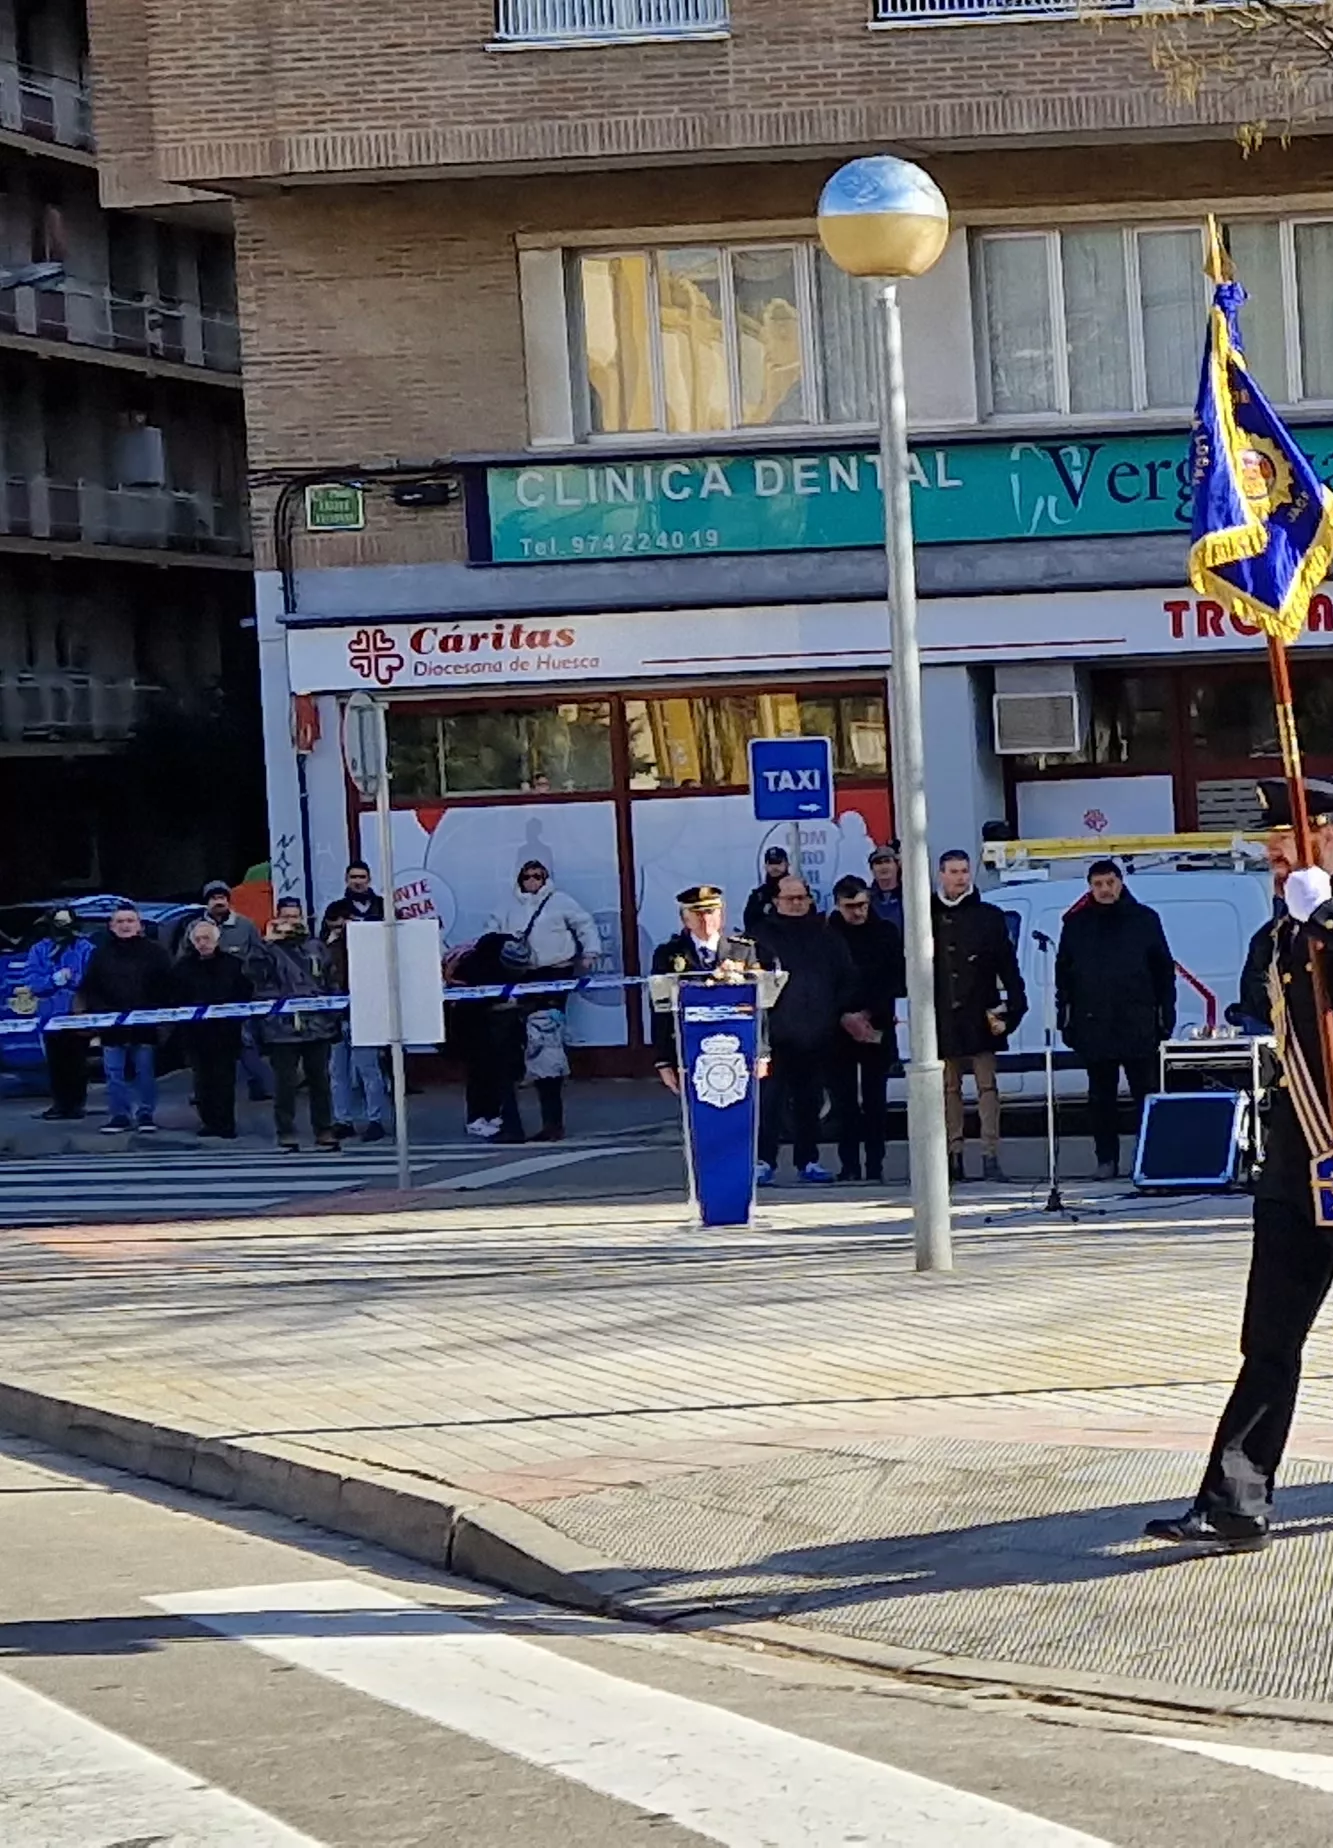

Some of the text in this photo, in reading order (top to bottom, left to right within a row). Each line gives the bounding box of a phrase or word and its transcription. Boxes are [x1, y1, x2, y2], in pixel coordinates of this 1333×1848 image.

[515, 449, 964, 508] CLINICA DENTAL
[518, 536, 568, 557] Tel.
[409, 623, 576, 656] Cáritas
[413, 655, 600, 677] Diocesana de Huesca
[762, 768, 822, 792] TAXI
